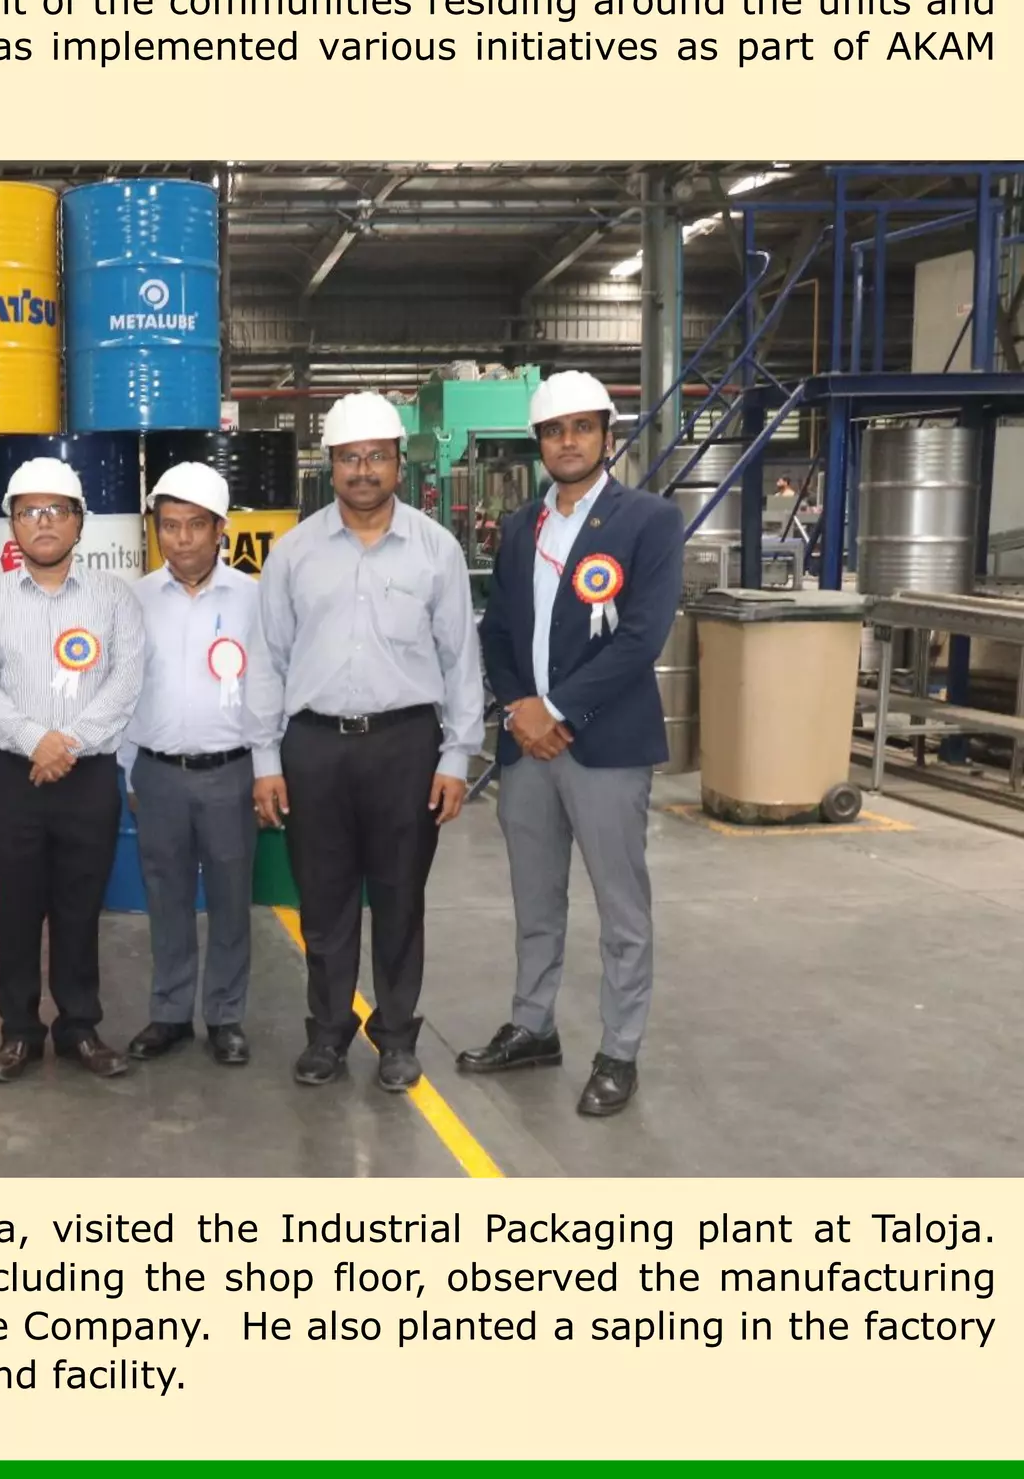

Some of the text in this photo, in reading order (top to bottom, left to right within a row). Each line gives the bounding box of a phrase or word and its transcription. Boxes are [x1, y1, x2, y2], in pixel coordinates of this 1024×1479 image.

[109, 313, 196, 331] METALUBE
[75, 543, 140, 570] emitsu
[53, 1213, 172, 1243] visited
[198, 1213, 257, 1243] the
[283, 1213, 459, 1243] Industrial
[488, 1213, 672, 1250] Packaging
[700, 1213, 792, 1250] plant
[815, 1215, 850, 1243] at
[872, 1213, 992, 1250] Taloja.
[53, 1359, 183, 1396] facility.
